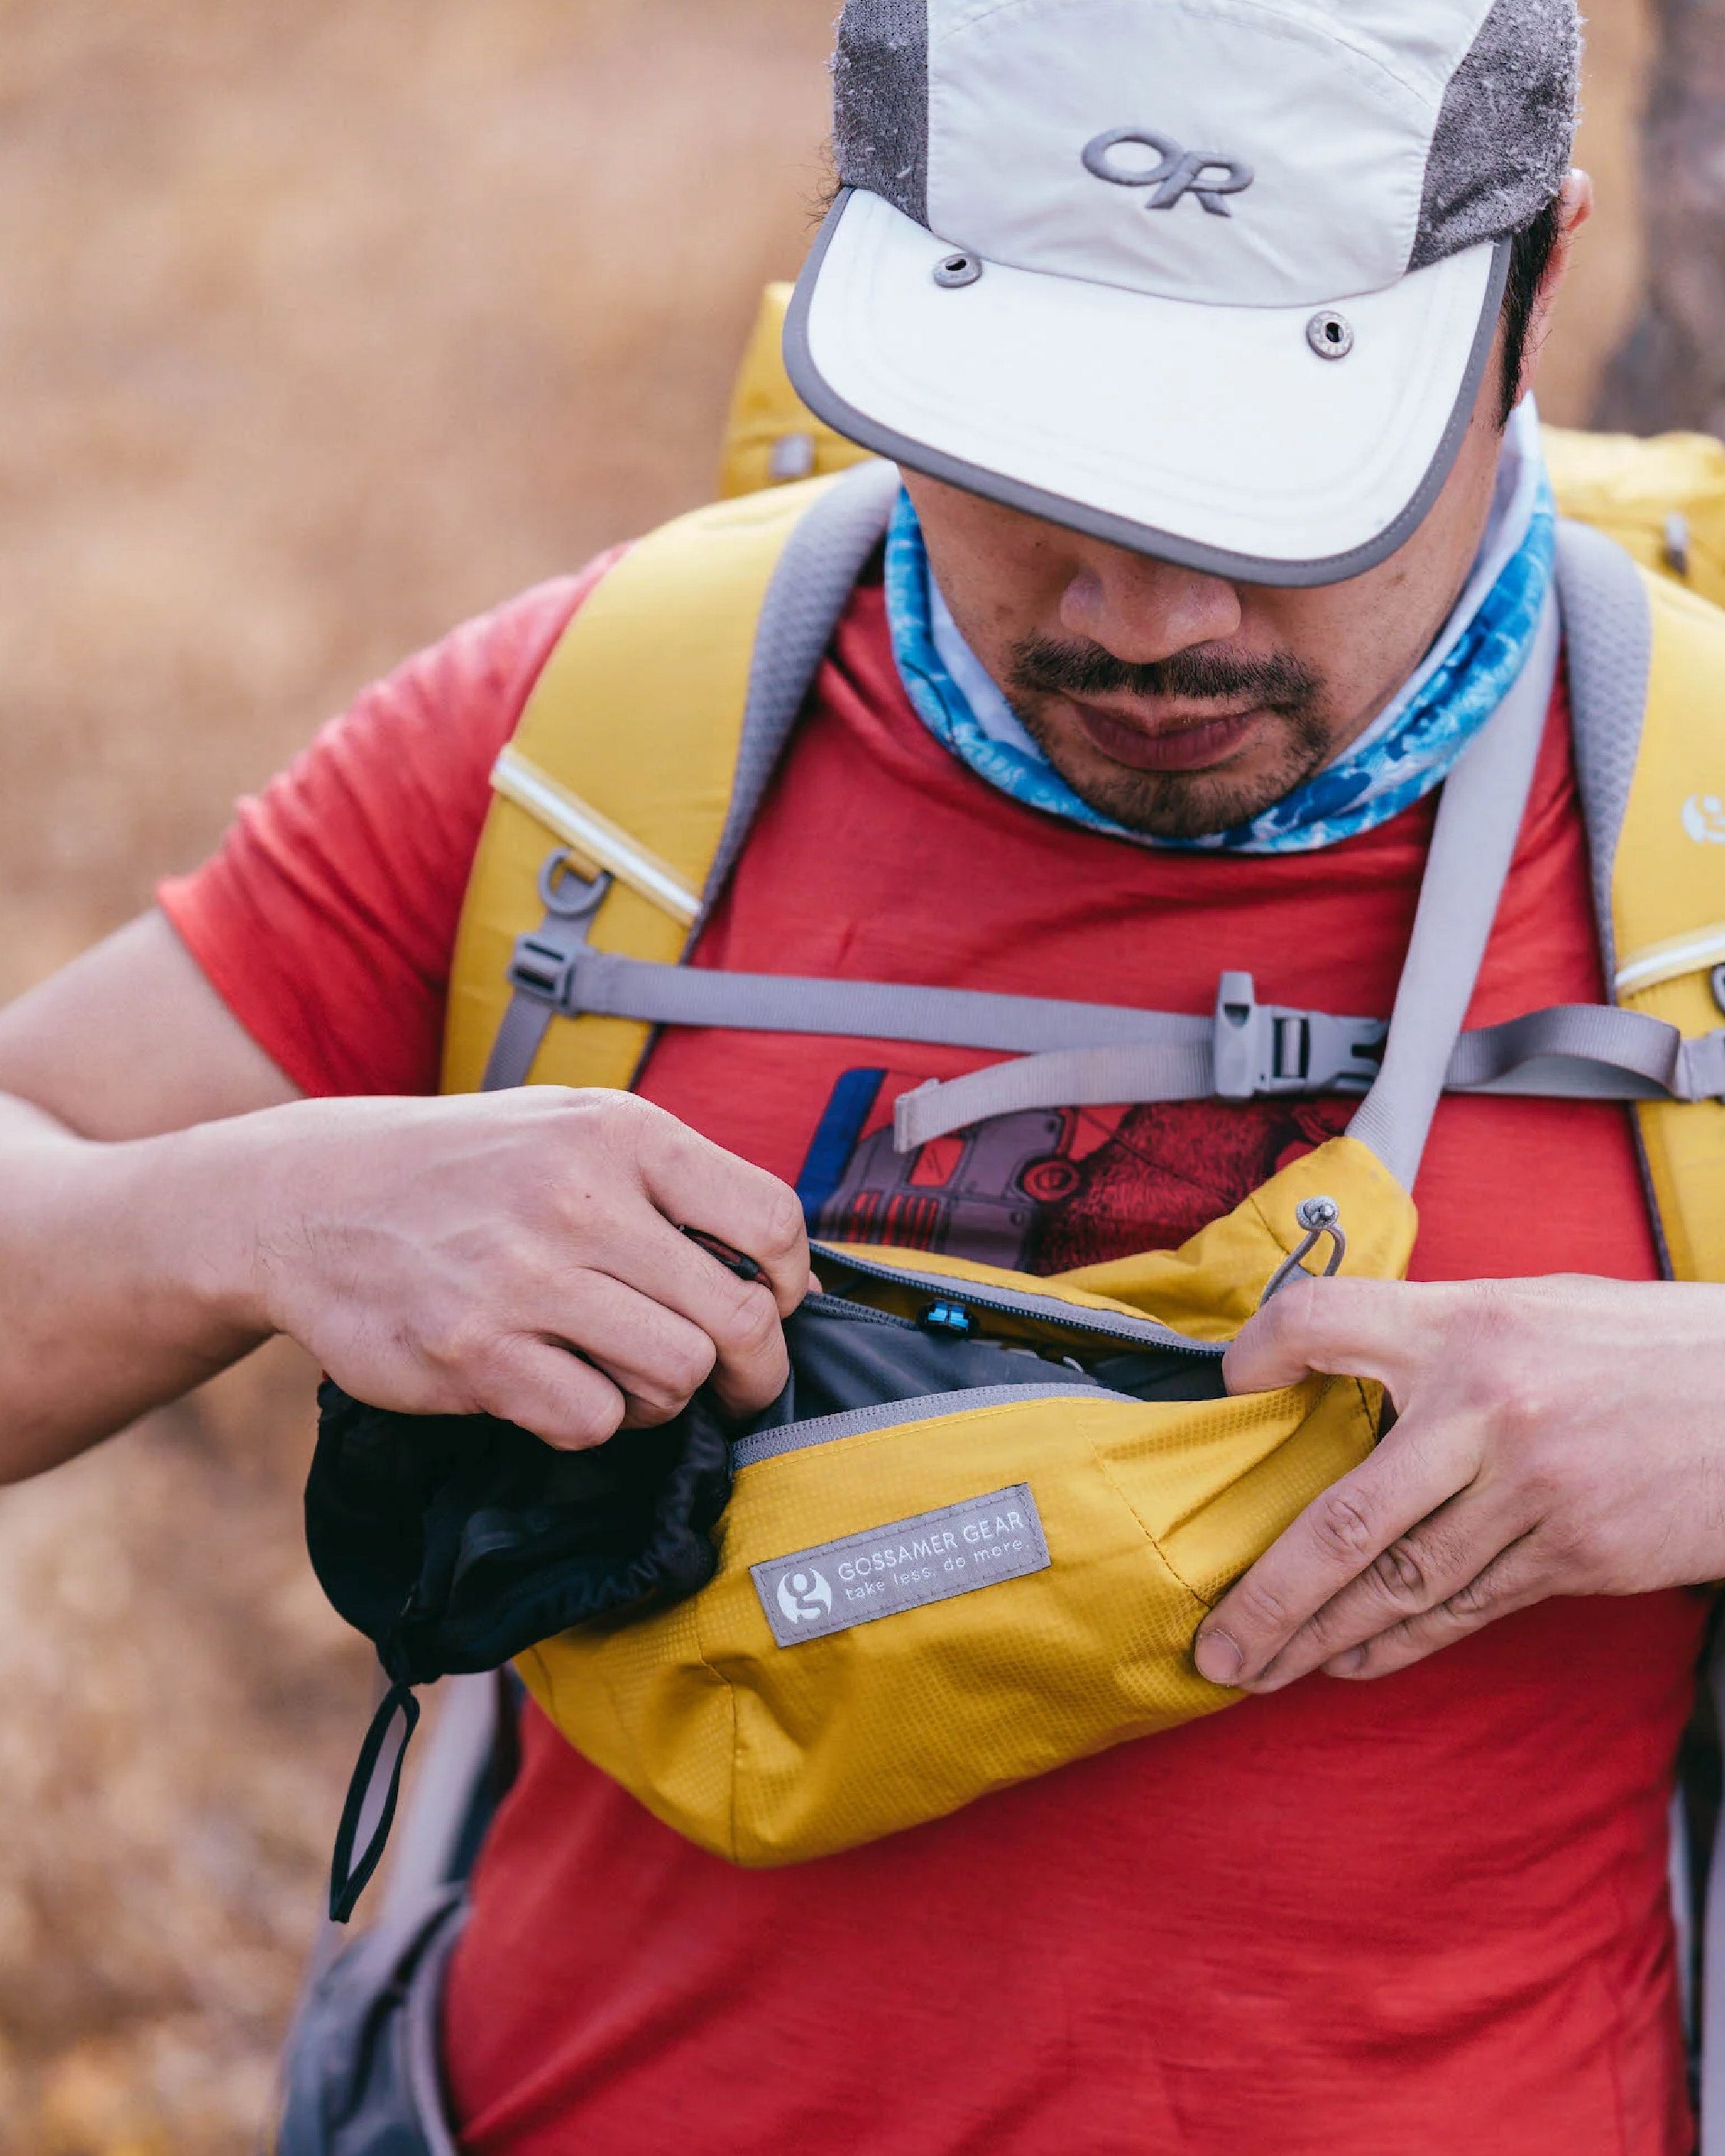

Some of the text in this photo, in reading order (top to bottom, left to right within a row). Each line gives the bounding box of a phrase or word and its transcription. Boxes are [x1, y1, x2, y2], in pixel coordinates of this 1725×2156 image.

[1080, 125, 1255, 218] OR
[838, 1511, 1024, 1580] GOSSAMER GEAR
[846, 1581, 885, 1600] take
[944, 1557, 965, 1571] do
